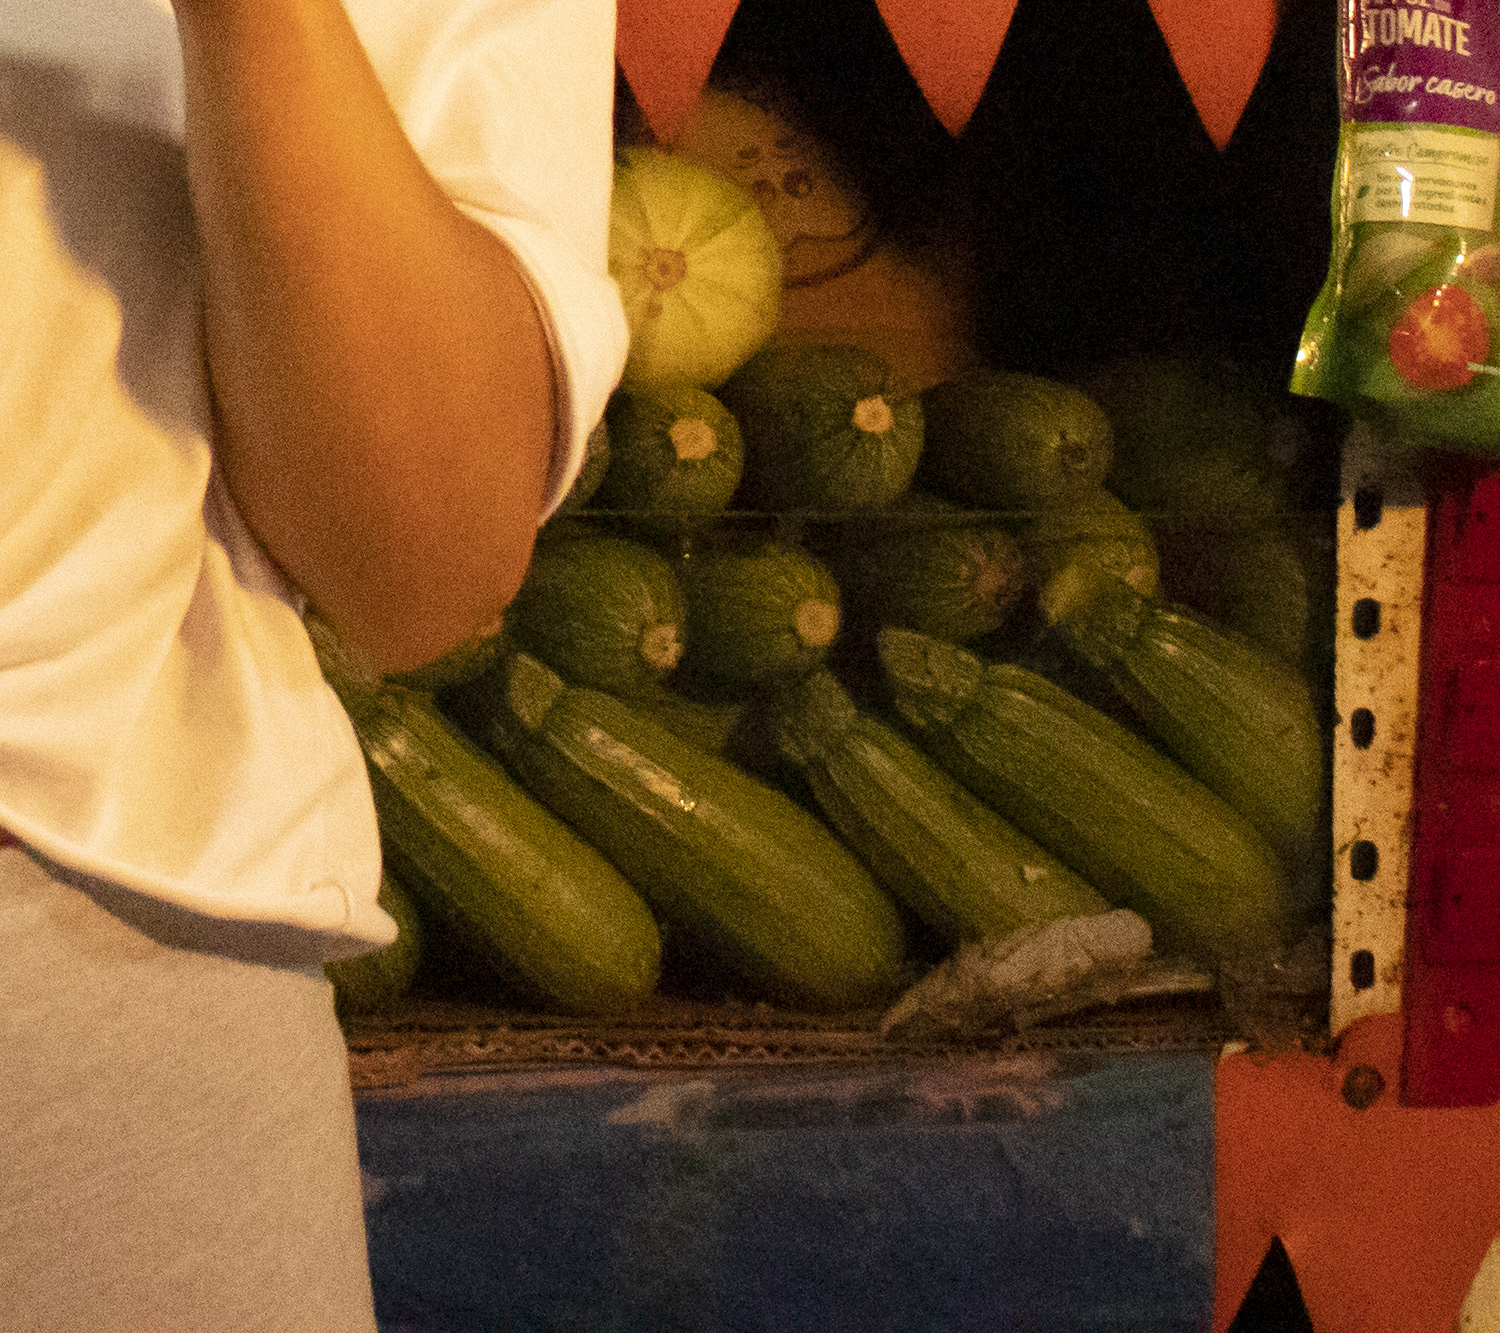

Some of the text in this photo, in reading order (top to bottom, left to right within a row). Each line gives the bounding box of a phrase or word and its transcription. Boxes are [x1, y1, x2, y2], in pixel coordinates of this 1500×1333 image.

[1366, 8, 1472, 57] TOMATE
[1356, 63, 1497, 105] Sabor casero
